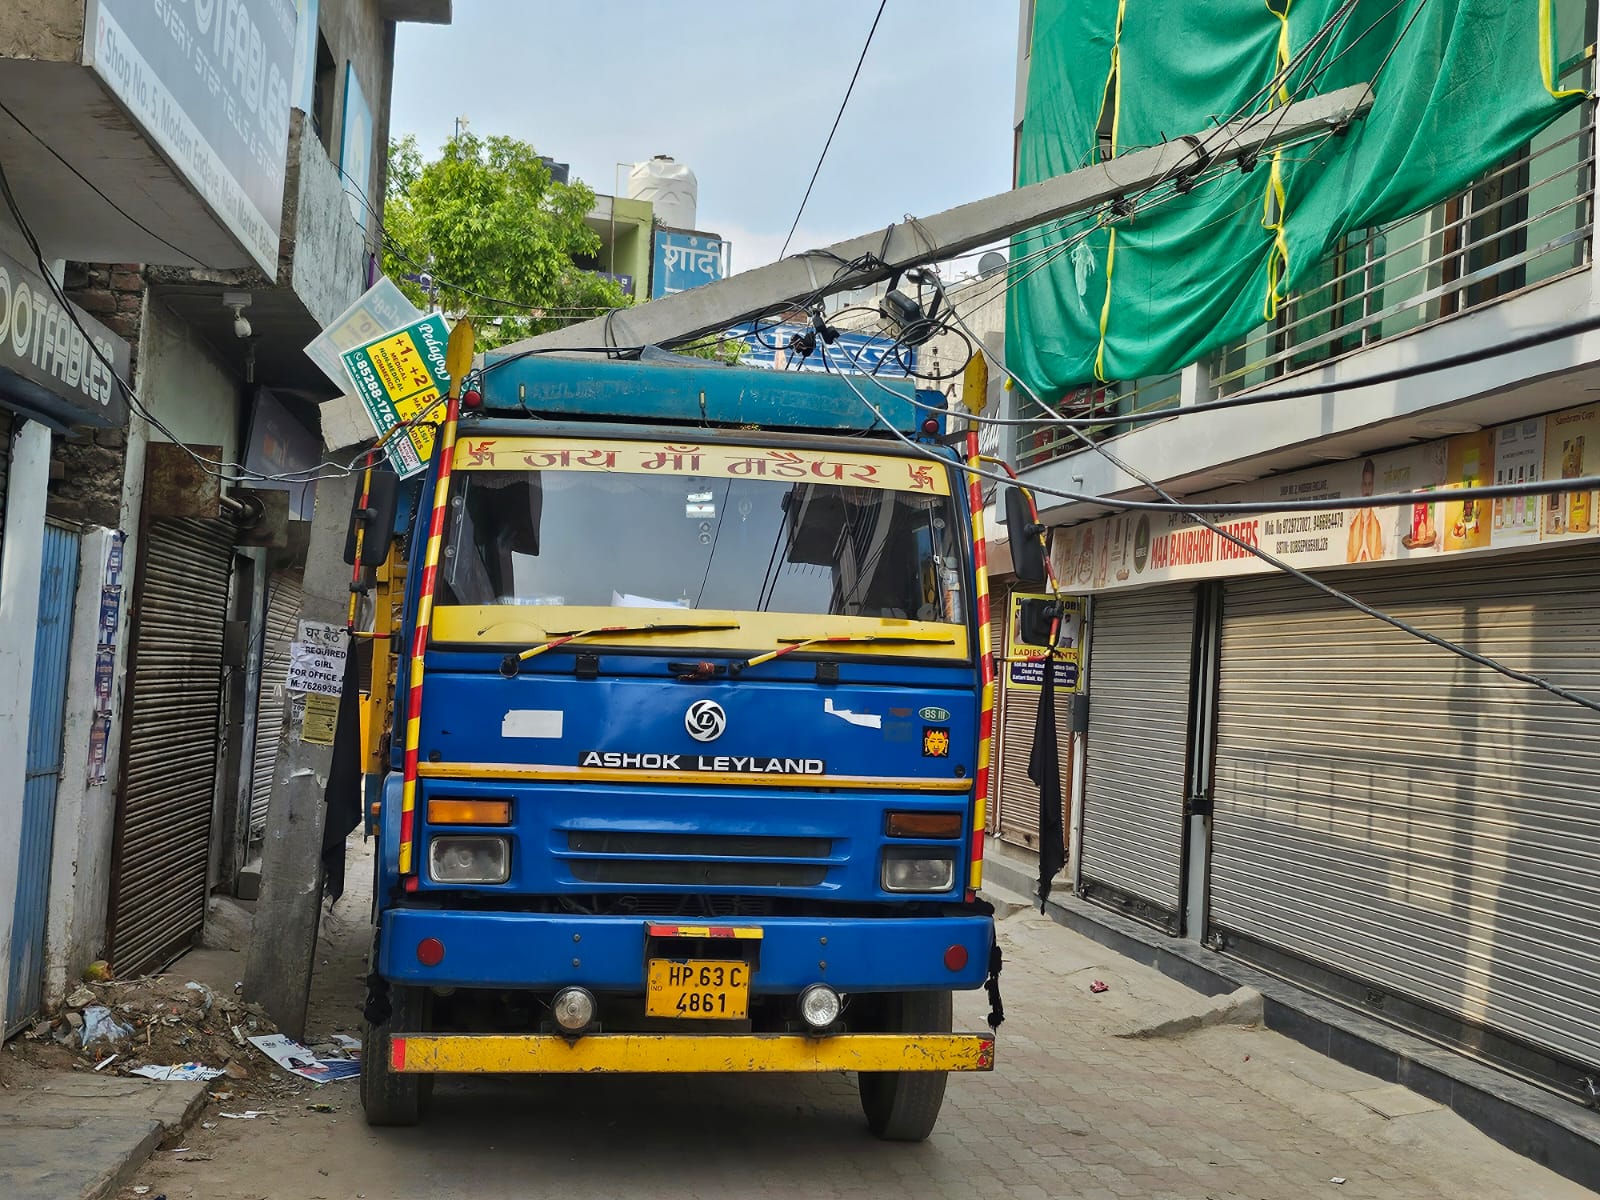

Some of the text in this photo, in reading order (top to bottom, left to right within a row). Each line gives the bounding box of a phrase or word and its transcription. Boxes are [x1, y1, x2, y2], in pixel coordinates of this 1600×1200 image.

[105, 27, 131, 104] Shop
[513, 449, 622, 468] जय
[1151, 520, 1258, 570] MAA BANBHORI TRADERS
[305, 646, 346, 659] REQUIRED
[1013, 648, 1041, 657] LADIES
[314, 660, 334, 669] GIRL
[290, 668, 307, 677] FOR
[308, 670, 337, 682] OFFICE
[925, 709, 936, 719] BS
[582, 751, 824, 774] ASHOK LEYLAND
[669, 966, 742, 988] HP 63 C
[676, 992, 726, 1013] 4861
